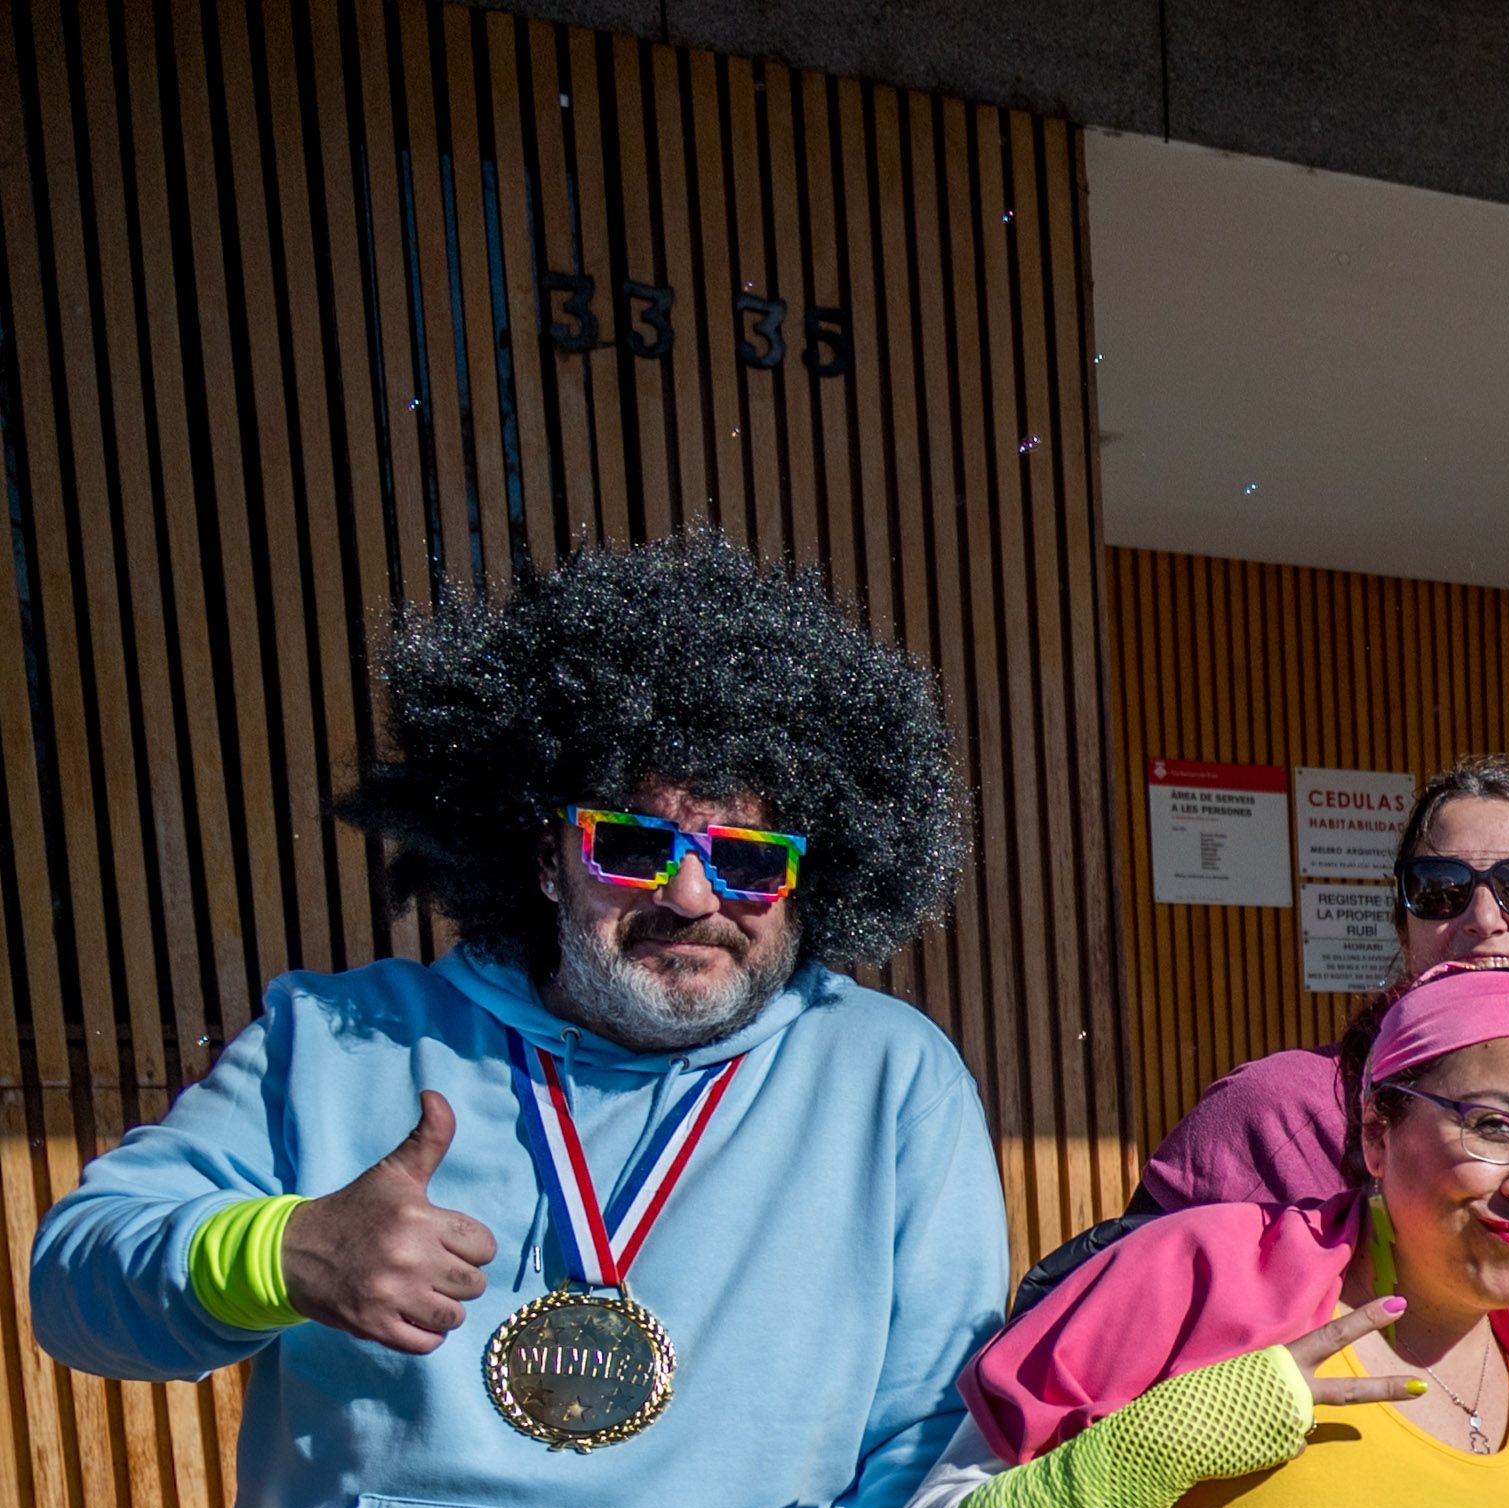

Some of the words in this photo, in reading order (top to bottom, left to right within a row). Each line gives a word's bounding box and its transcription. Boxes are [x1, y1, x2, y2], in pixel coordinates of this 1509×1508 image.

[541, 272, 675, 360] 33
[736, 293, 853, 378] 35
[1200, 793, 1213, 802] DE
[1215, 794, 1255, 805] SERVEIS
[1309, 790, 1404, 811] CEDULAS
[1171, 804, 1178, 812] A
[1181, 805, 1198, 814] LES
[1202, 806, 1252, 816] PERSONES
[1318, 894, 1381, 907] REGISTRE
[1317, 909, 1333, 920] LA
[1347, 924, 1377, 937] RUBÍ
[1344, 943, 1383, 951] HORARI
